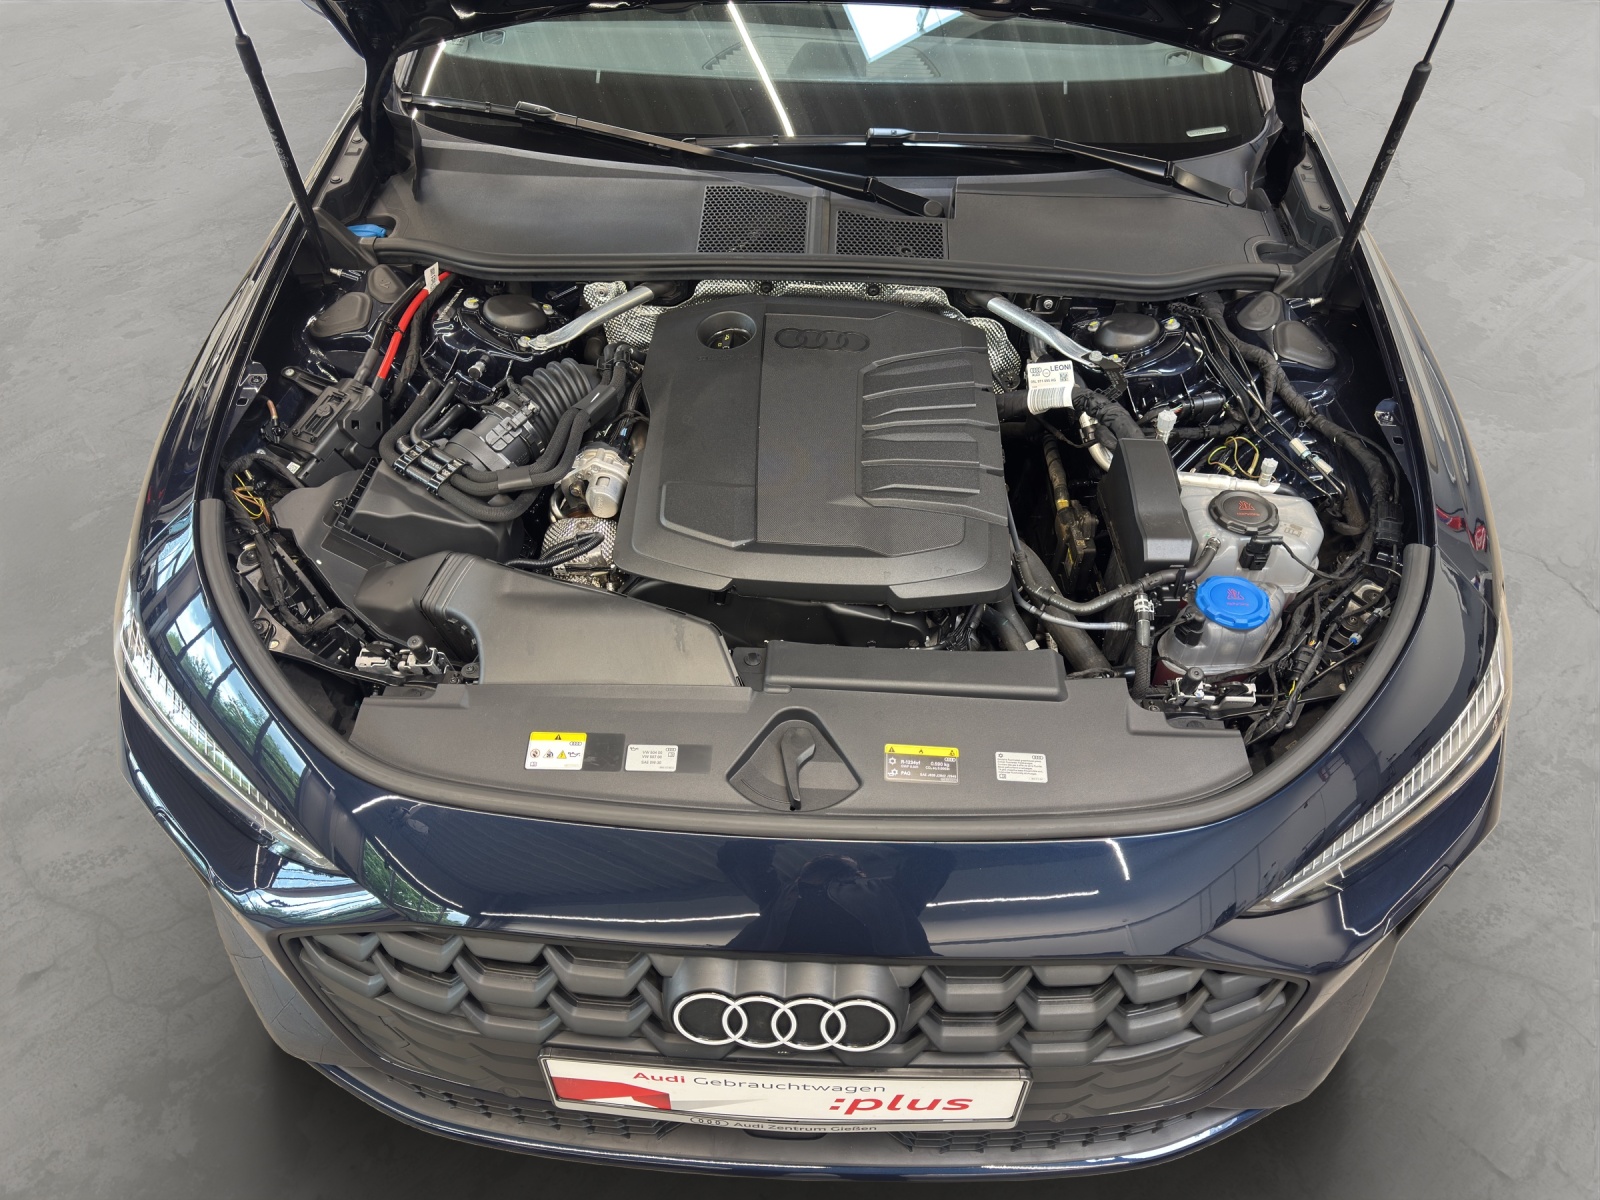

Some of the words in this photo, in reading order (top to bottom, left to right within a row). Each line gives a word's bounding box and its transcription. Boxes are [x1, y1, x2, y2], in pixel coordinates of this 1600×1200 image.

[633, 1072, 685, 1084] Audi
[693, 1077, 886, 1094] Gebrauchtwagen
[734, 1122, 764, 1130] Audi
[768, 1124, 827, 1132] Zentrum
